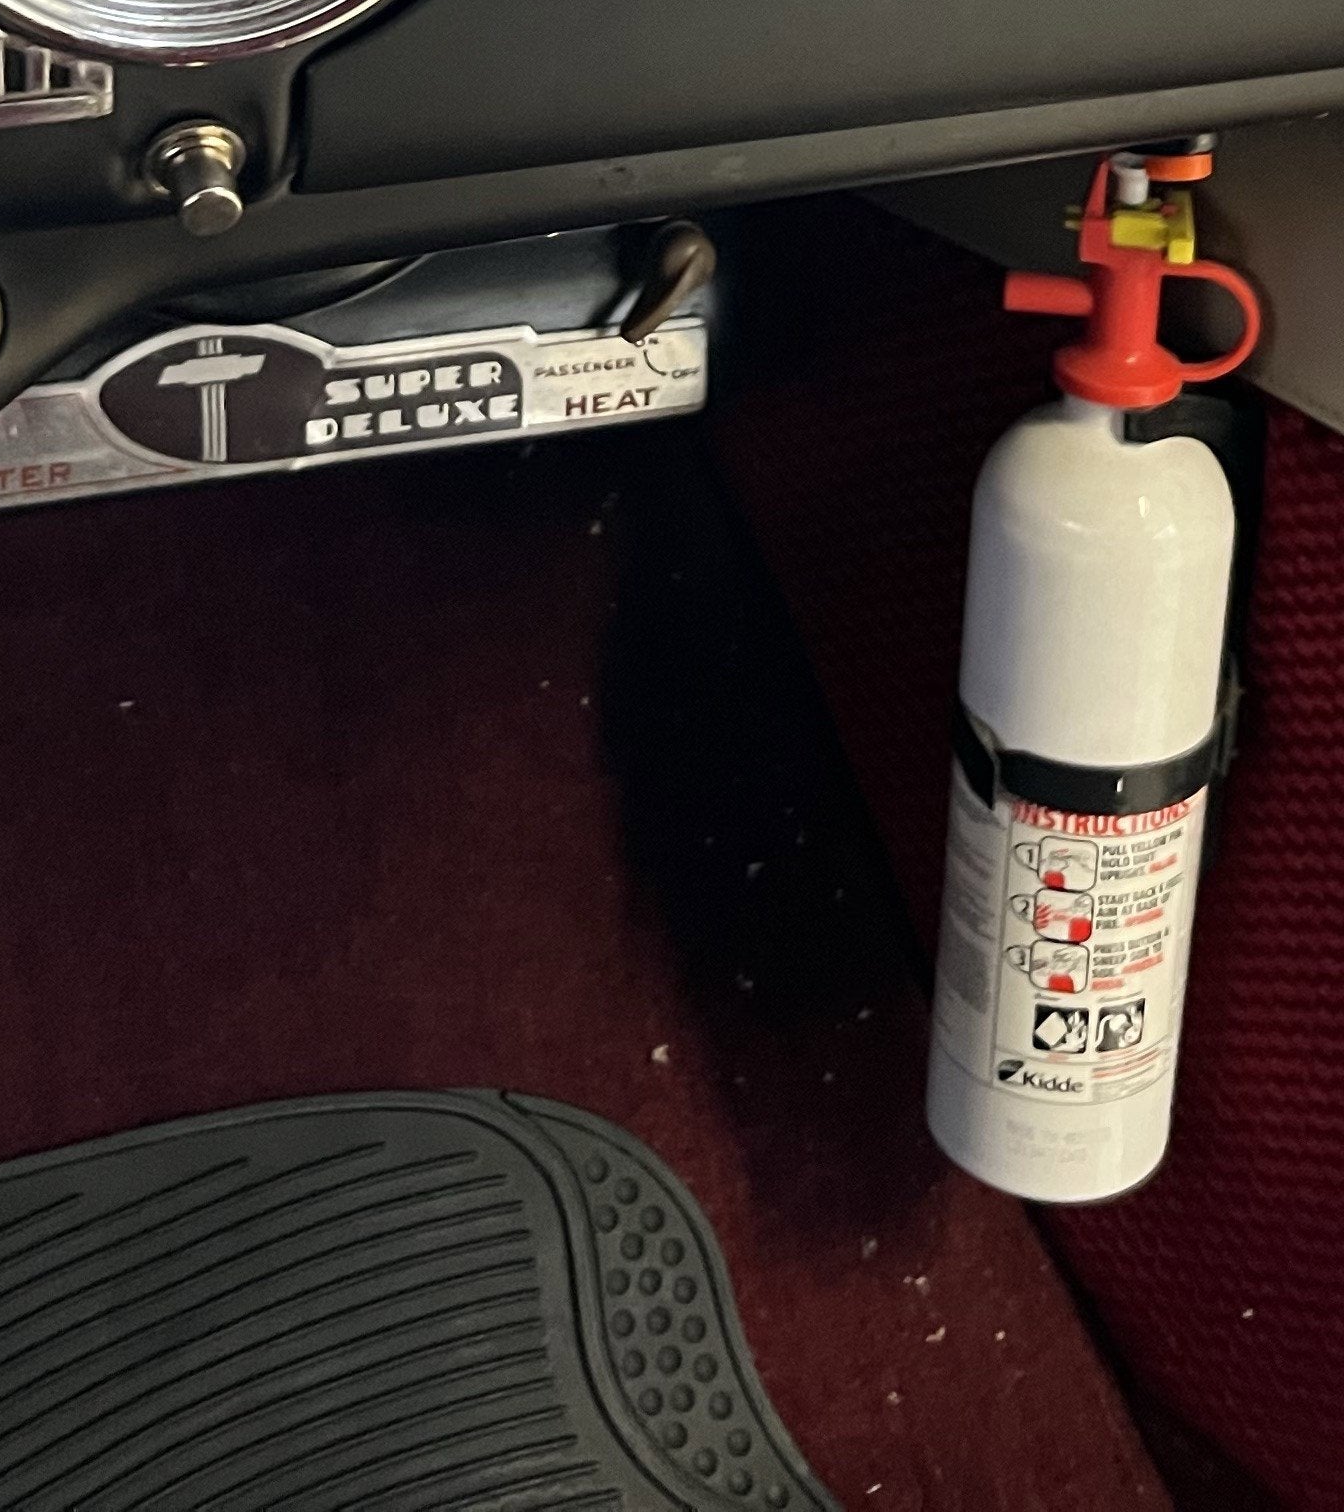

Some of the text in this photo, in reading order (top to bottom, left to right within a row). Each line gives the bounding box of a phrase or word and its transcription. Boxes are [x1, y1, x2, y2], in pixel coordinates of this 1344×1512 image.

[533, 356, 635, 378] PASSENGER
[325, 360, 502, 406] SUPER
[565, 386, 660, 417] HEAT
[306, 393, 518, 446] DELUXE
[1012, 801, 1191, 836] INSTRUCTIONS
[1027, 848, 1034, 864] 1
[1102, 844, 1128, 856] PULL
[1019, 898, 1030, 914] 2
[1097, 893, 1129, 906] START
[1022, 1071, 1084, 1094] Kidde
